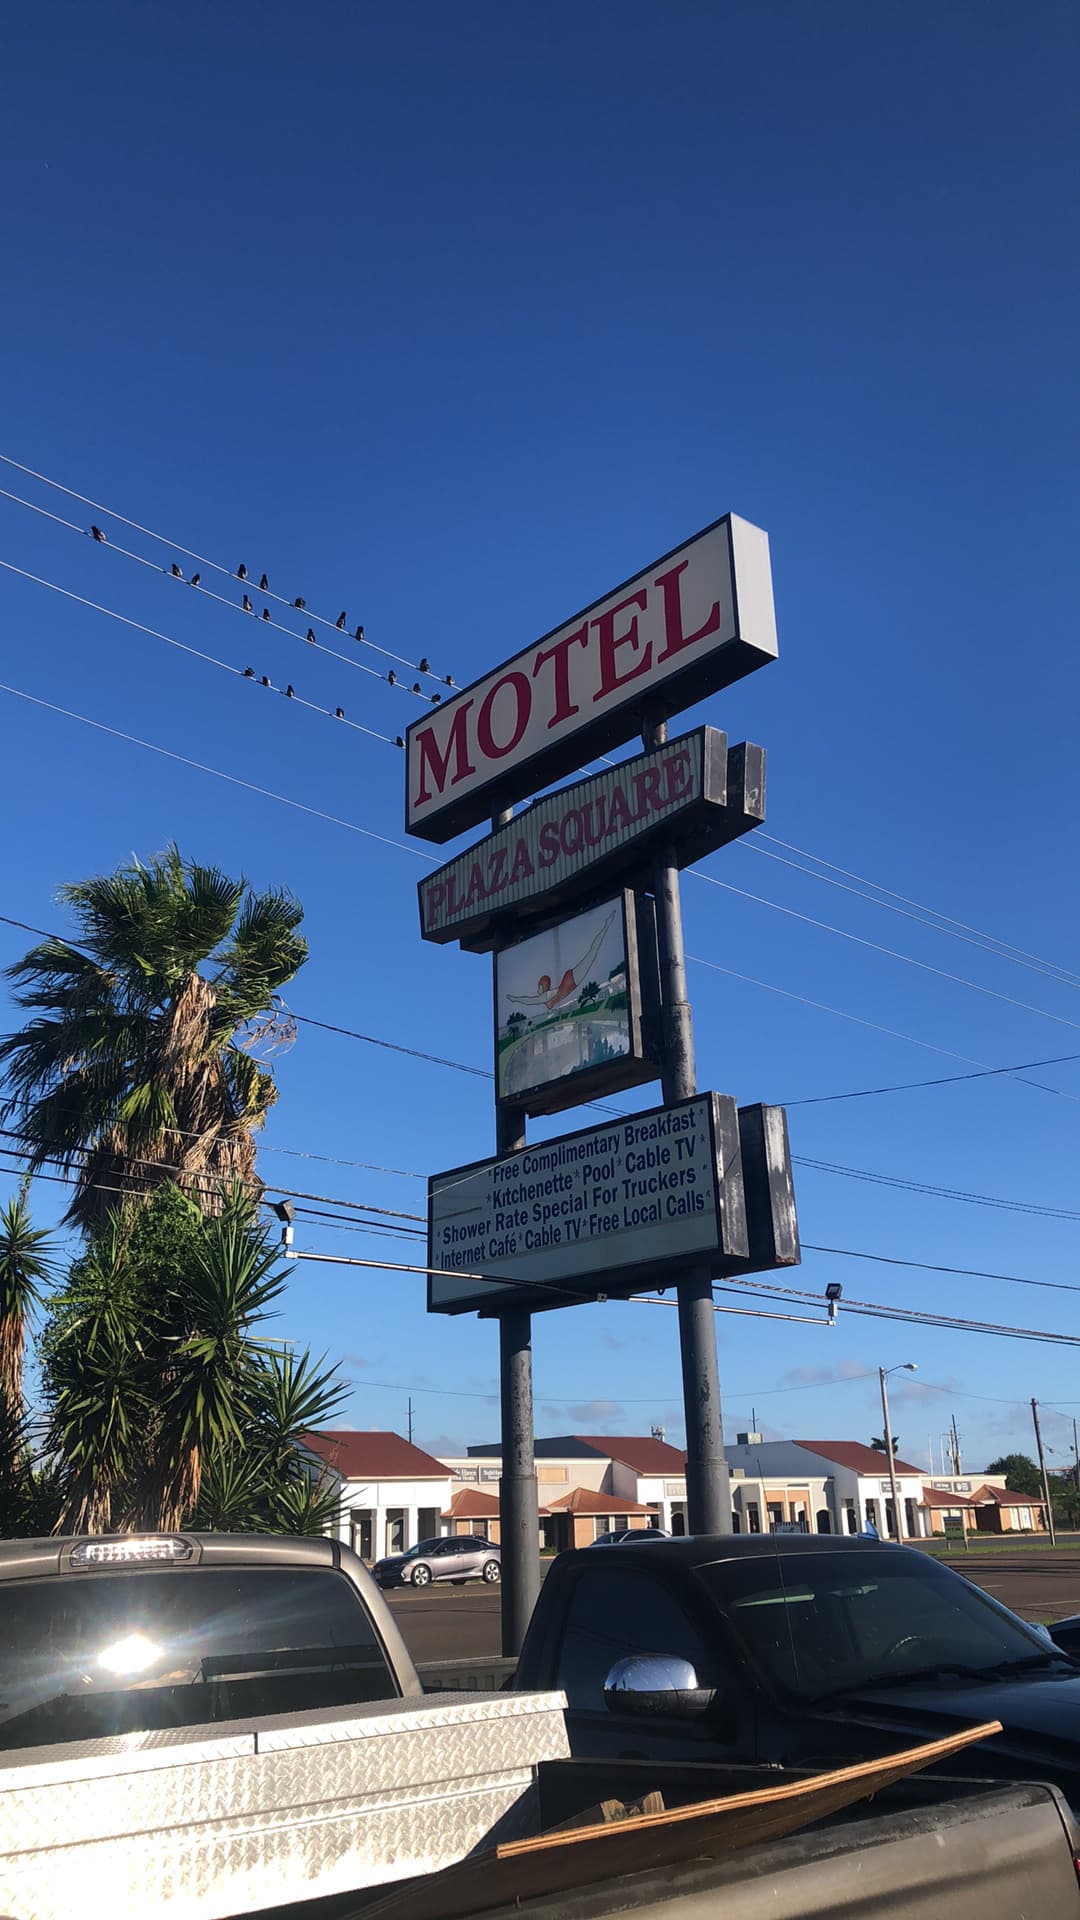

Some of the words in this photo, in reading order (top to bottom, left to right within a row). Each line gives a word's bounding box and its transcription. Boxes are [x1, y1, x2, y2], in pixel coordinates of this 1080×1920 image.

[414, 560, 720, 808] MOTEL
[426, 837, 535, 927] PLAZA
[538, 749, 694, 868] SQUARE
[492, 1172, 572, 1210] Kitchenette
[583, 1158, 615, 1185] Pool
[625, 1144, 670, 1174] Cable
[675, 1135, 696, 1163] TV
[493, 1162, 519, 1184] Free
[523, 1134, 621, 1175] Complimentary
[625, 1108, 696, 1147] Breakfast
[441, 1243, 486, 1270] Internet
[489, 1231, 517, 1259] Café
[525, 1225, 561, 1250] Cable
[564, 1219, 581, 1241] TV
[589, 1213, 619, 1236] Free
[624, 1198, 661, 1227] Local
[666, 1190, 705, 1217] Calls
[443, 1218, 491, 1245] Shower
[495, 1205, 528, 1231] Rate
[532, 1191, 588, 1223] Special
[593, 1186, 618, 1208] For
[622, 1167, 696, 1200] Truckers
